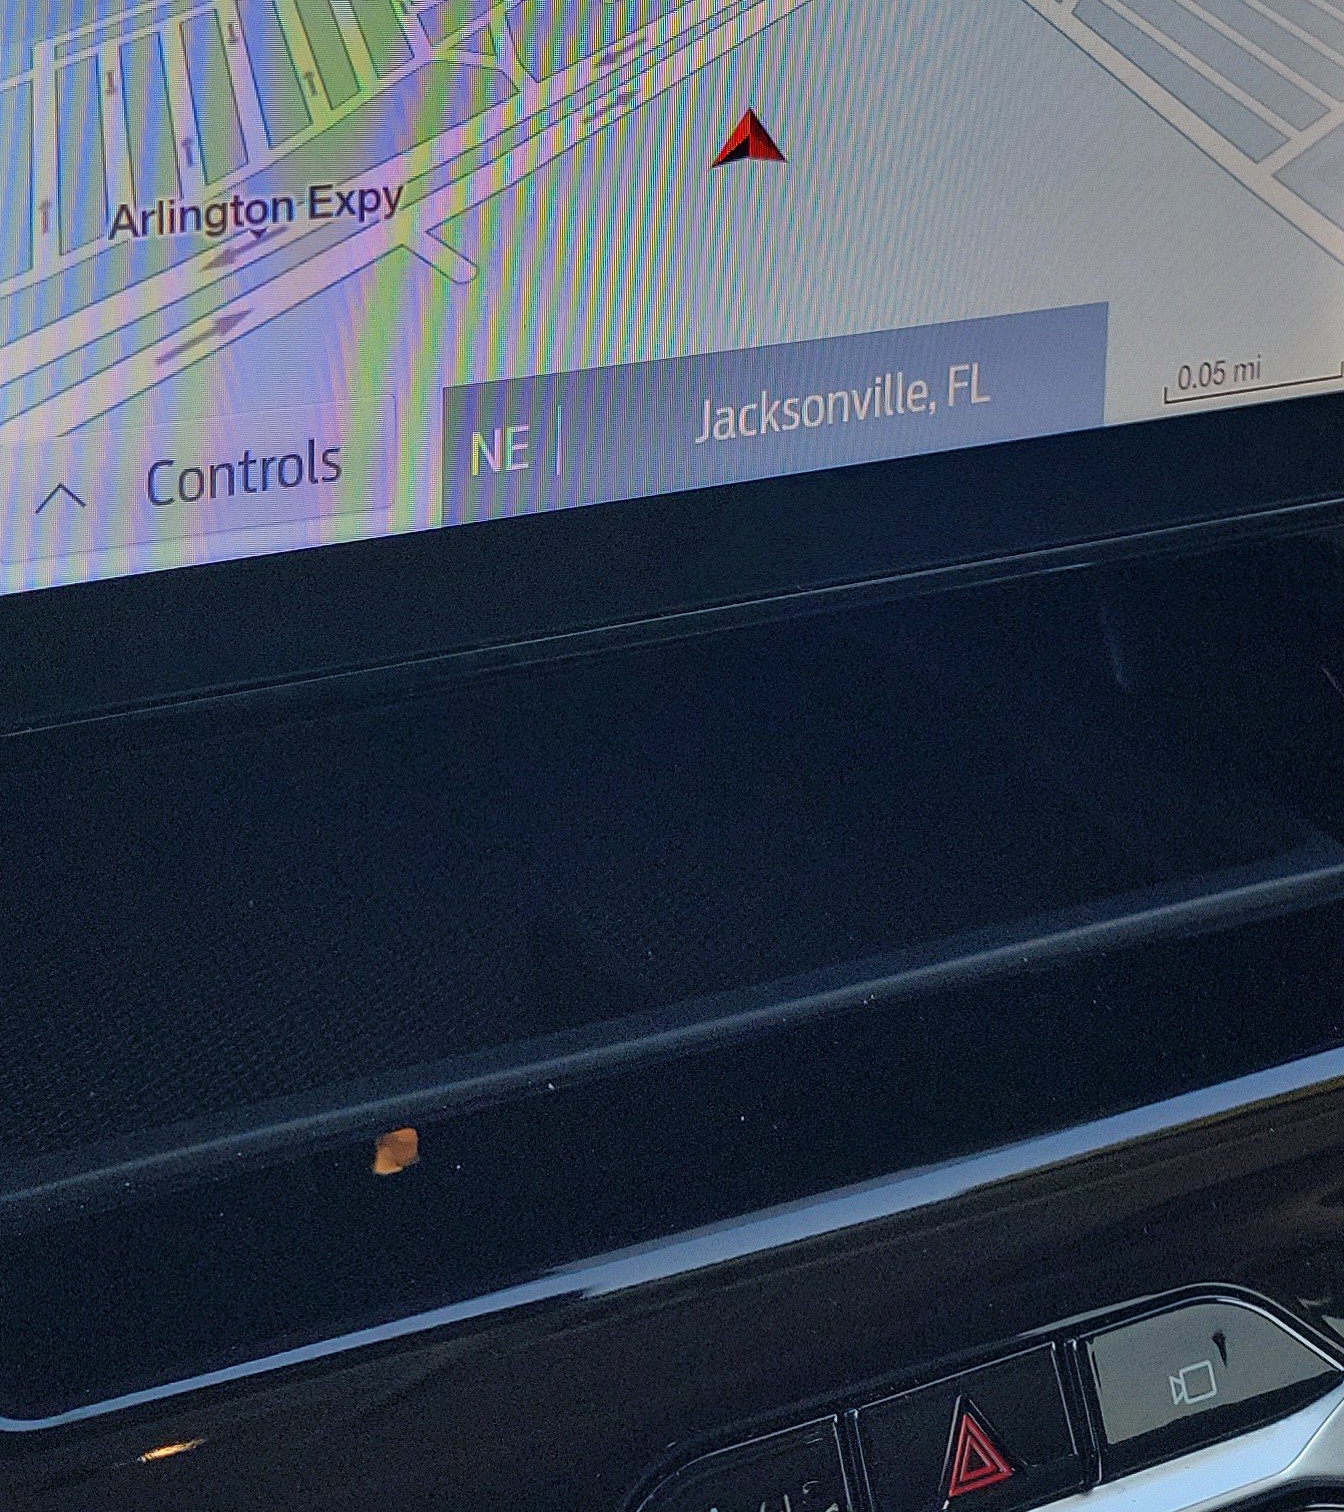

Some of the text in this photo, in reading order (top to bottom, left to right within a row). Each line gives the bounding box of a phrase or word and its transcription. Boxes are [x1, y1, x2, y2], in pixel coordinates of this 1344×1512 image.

[109, 183, 405, 240] Arlington Expy
[1177, 354, 1262, 390] 0.05 mi
[694, 362, 991, 444] Jacksonville, FL
[146, 438, 343, 507] Controls
[471, 424, 531, 476] NE
